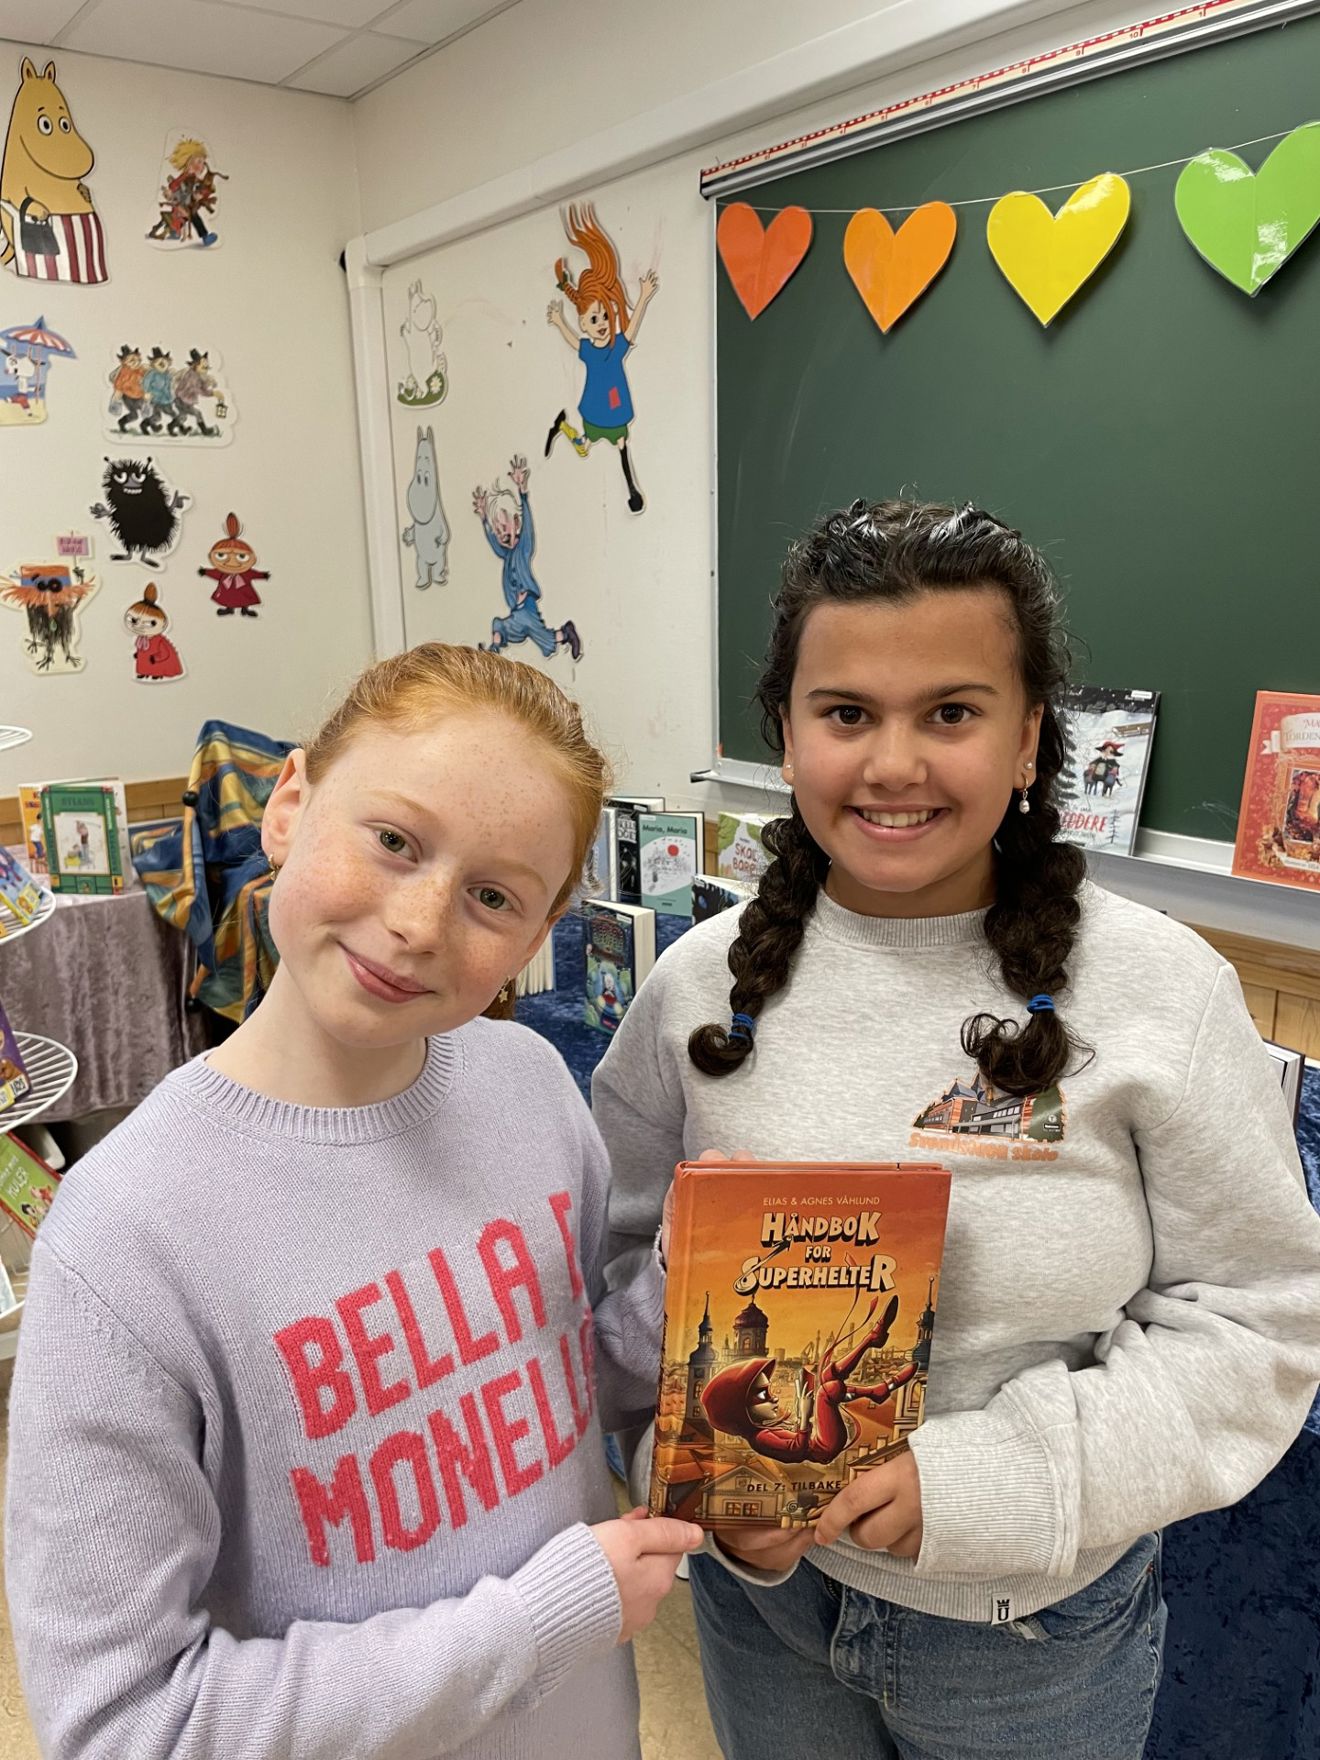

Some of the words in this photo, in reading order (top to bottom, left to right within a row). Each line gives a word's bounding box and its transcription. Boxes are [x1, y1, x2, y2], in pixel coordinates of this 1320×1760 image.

[763, 1197, 787, 1206] ELIAS
[800, 1197, 833, 1206] AGNES
[837, 1196, 880, 1205] VÅHLUND
[760, 1211, 882, 1247] HÅNDBOK
[804, 1245, 832, 1263] FOR
[733, 1254, 897, 1296] SUPERHELTER
[273, 1218, 548, 1440] BELLA
[747, 1483, 768, 1492] DEL
[774, 1482, 785, 1491] 7:
[791, 1480, 841, 1491] TILBAKE
